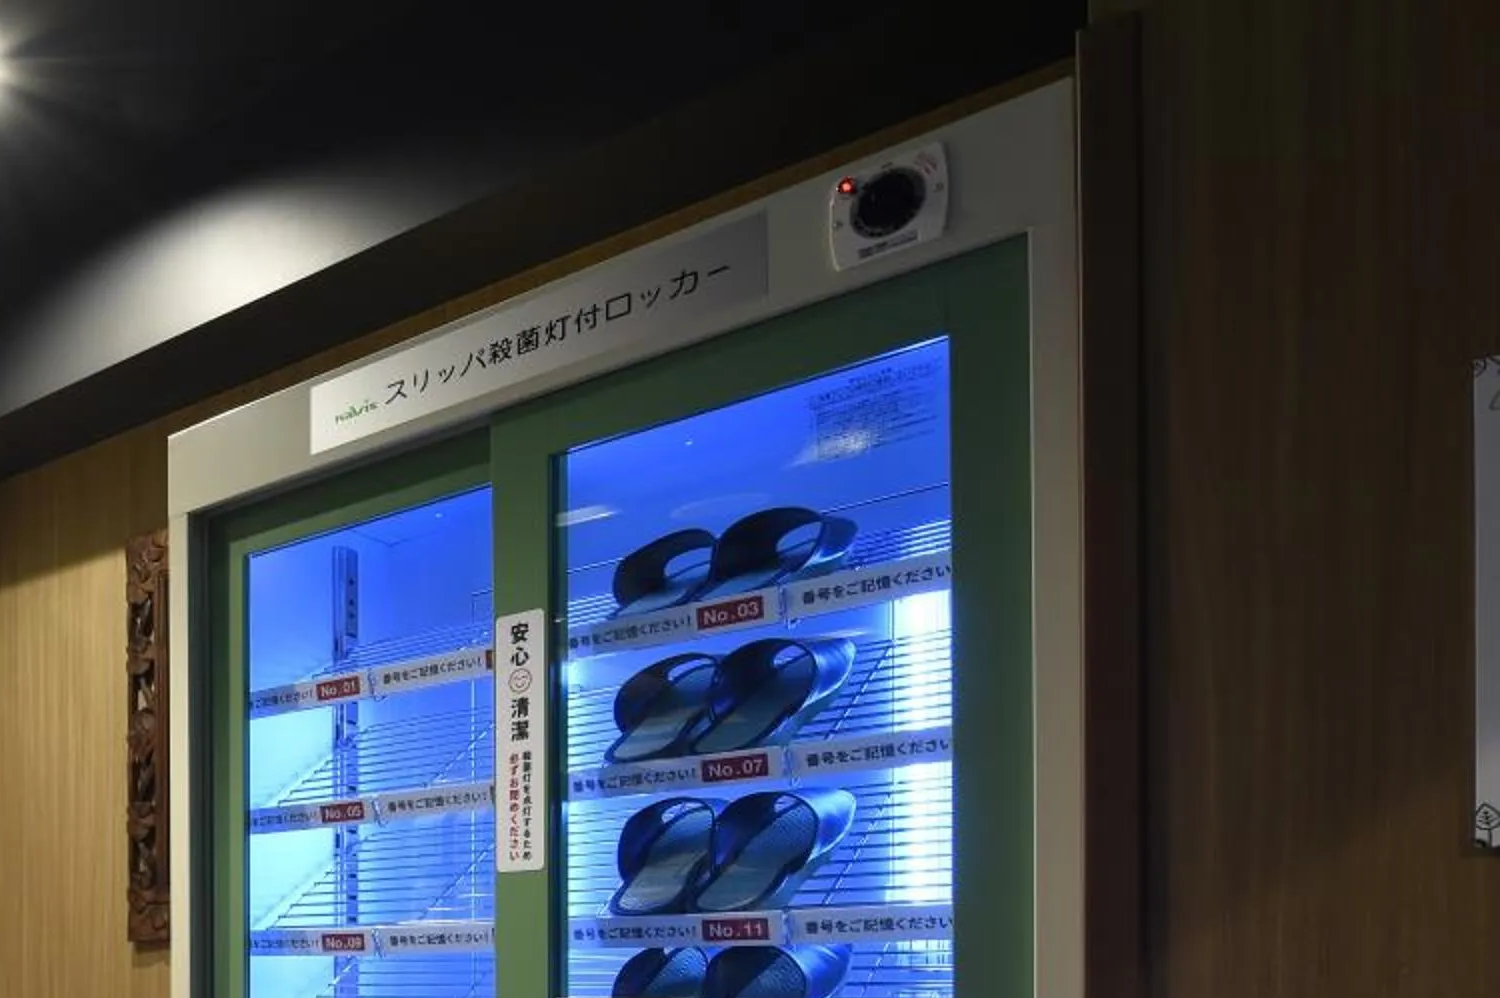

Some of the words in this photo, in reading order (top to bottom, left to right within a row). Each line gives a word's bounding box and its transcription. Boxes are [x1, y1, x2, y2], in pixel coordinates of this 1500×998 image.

[385, 263, 731, 405] スリッパ殺菌灯付ロッカー
[702, 601, 760, 625] No.03
[510, 623, 529, 667] 安心
[510, 698, 529, 741] 清潔
[708, 759, 763, 779] No.07
[709, 923, 762, 938] No.11
